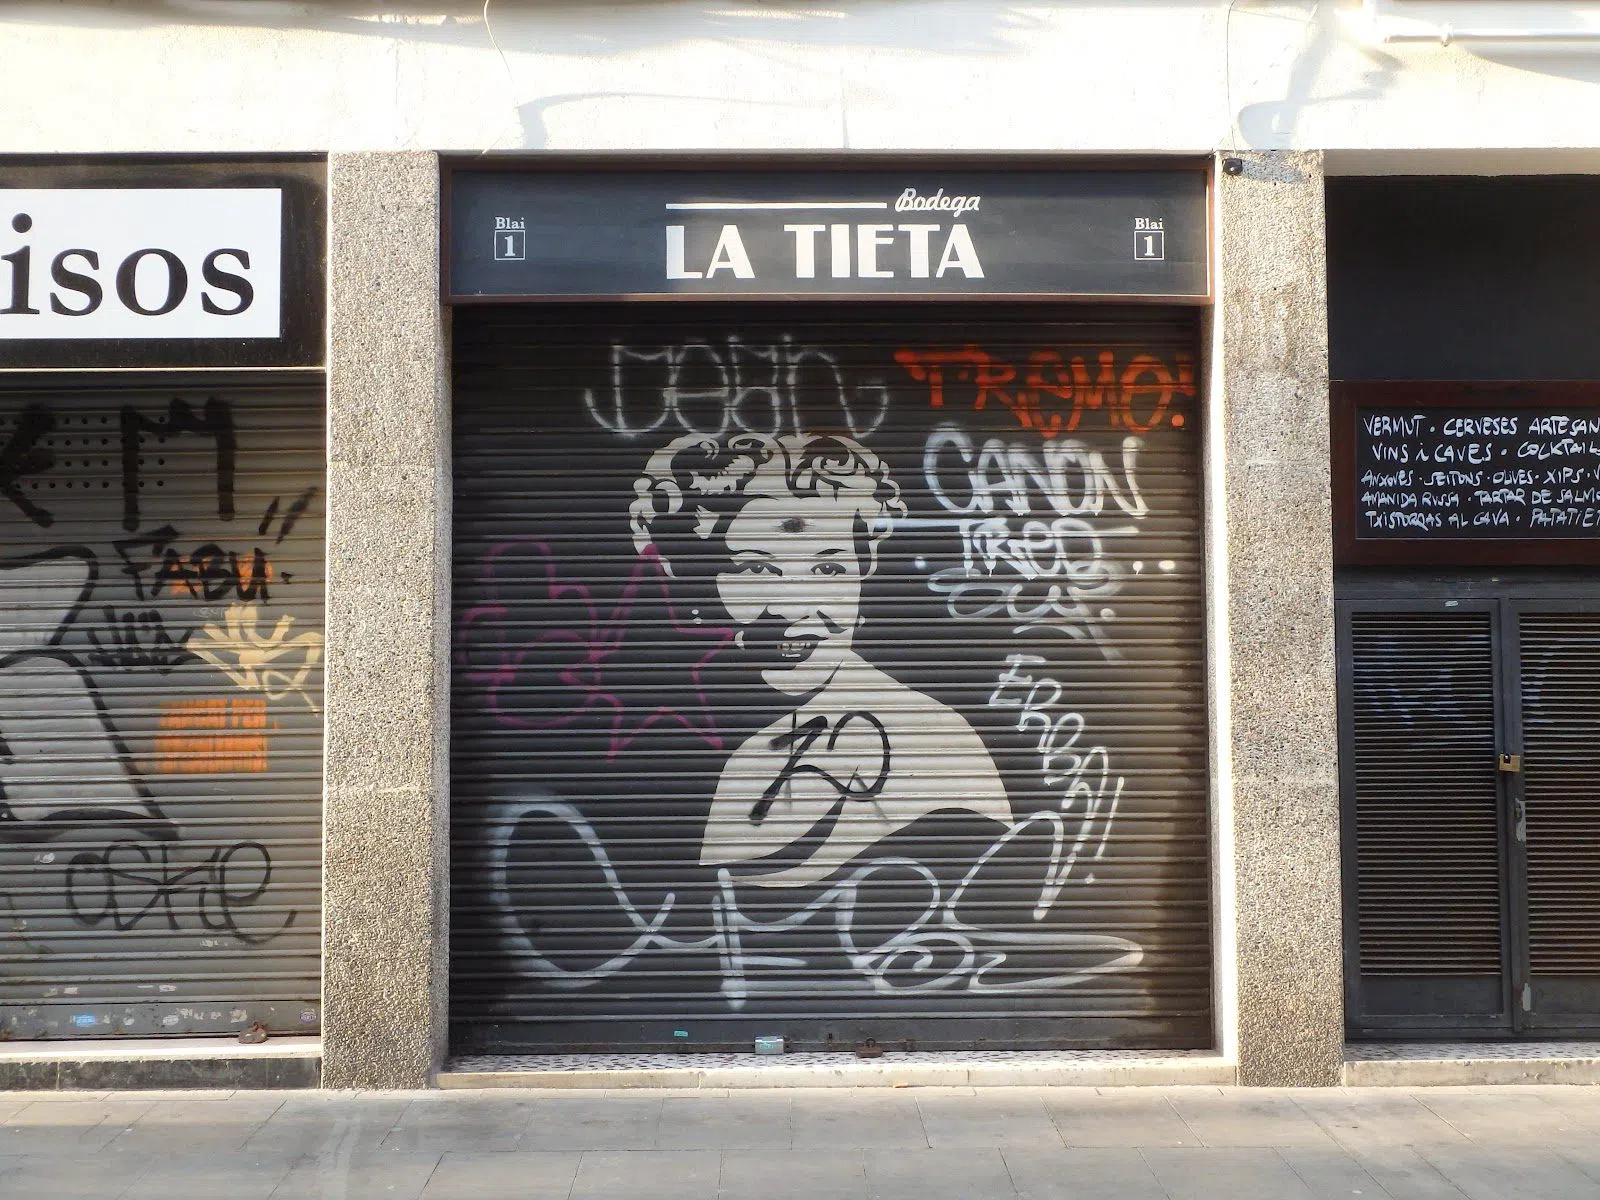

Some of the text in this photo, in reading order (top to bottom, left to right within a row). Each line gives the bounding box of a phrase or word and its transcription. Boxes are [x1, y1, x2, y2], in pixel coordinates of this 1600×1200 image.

[894, 188, 981, 217] Bodega
[494, 216, 526, 230] Blai
[1134, 217, 1164, 230] Blai
[504, 235, 516, 257] 1
[665, 223, 985, 279] LA TIETA
[1143, 235, 1155, 257] 1
[0, 212, 254, 316] isos
[1363, 415, 1427, 438] VERMUT
[1443, 416, 1518, 437] CERVESES
[1372, 442, 1409, 463] VINS
[1434, 443, 1492, 464] CAVES
[1360, 469, 1414, 487] ANXOVES
[1423, 470, 1483, 487] SEITONS
[1543, 466, 1584, 484] XIPS
[1361, 491, 1417, 508] AMANIDA
[1422, 491, 1459, 507] RUSSA
[1474, 488, 1526, 506] TARTAR
[1531, 489, 1552, 504] DE
[1448, 513, 1469, 528] AL
[1473, 508, 1509, 526] CAVA
